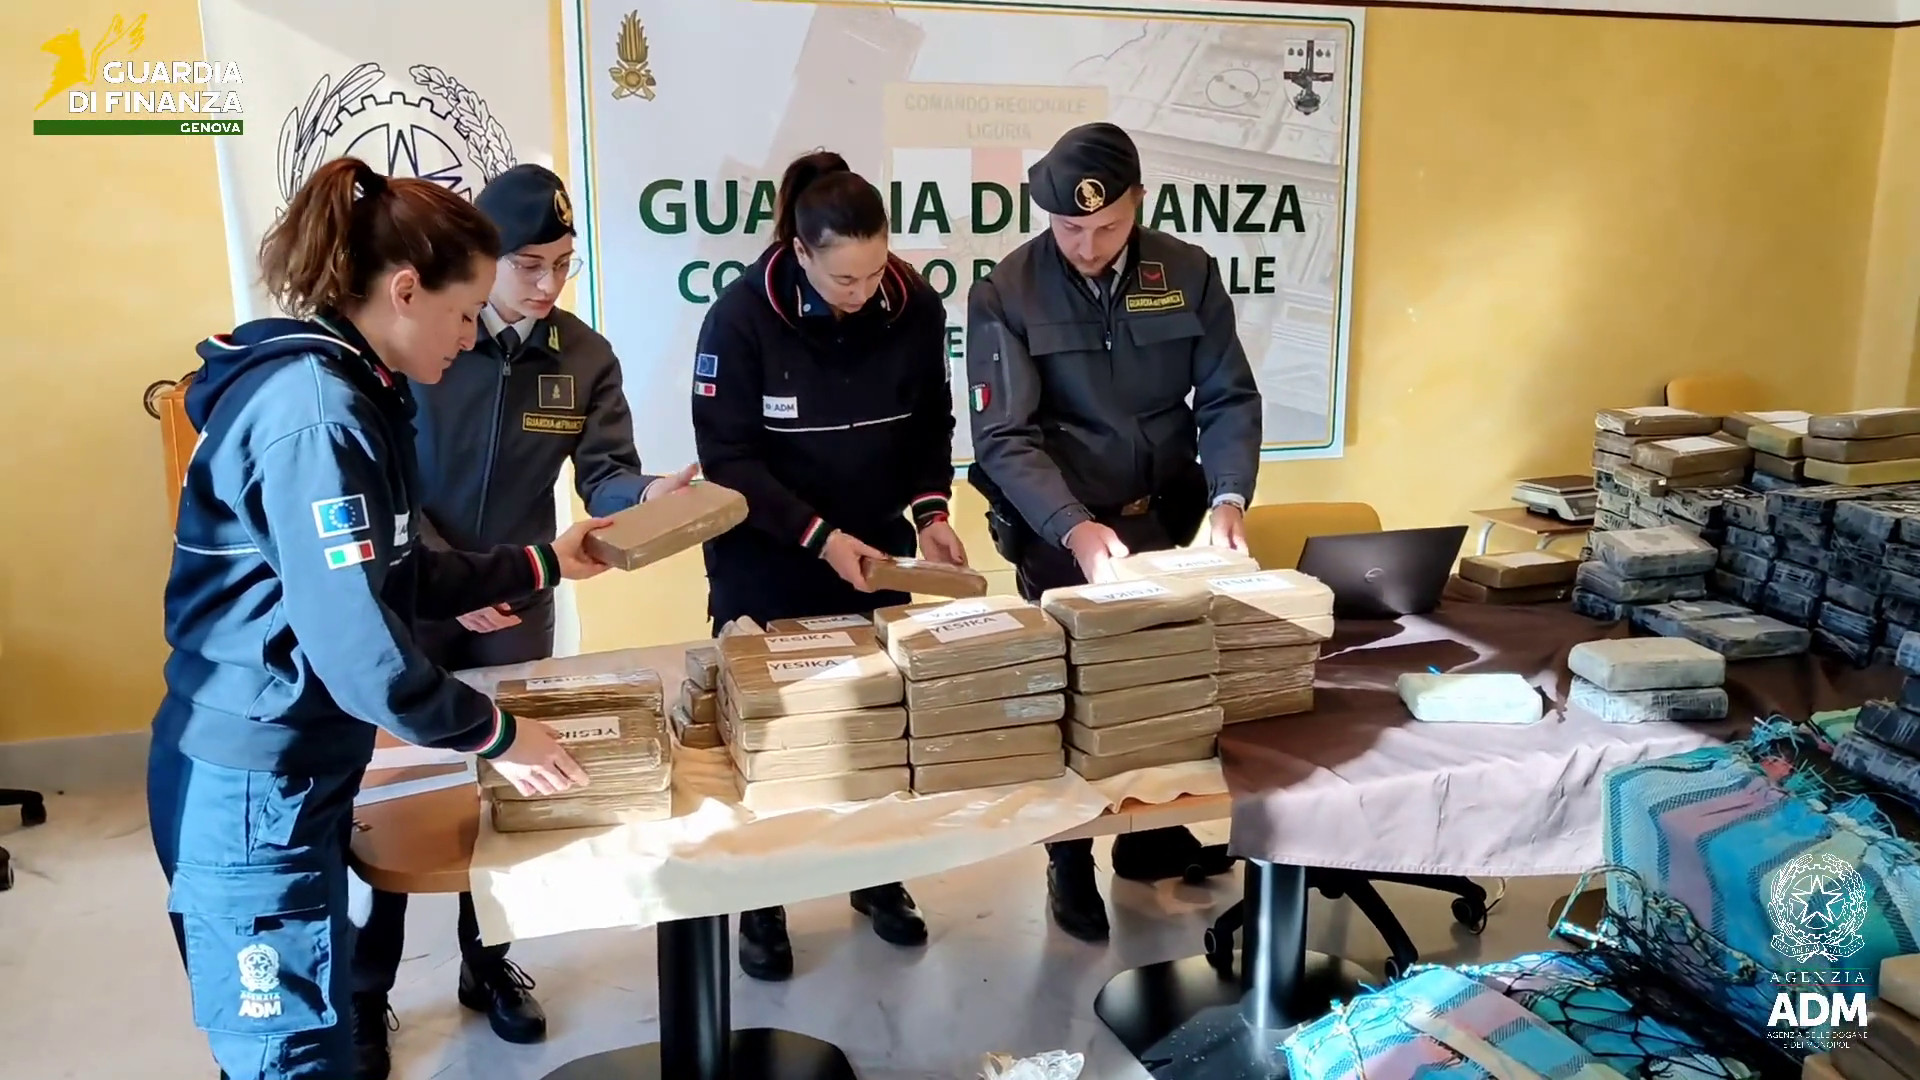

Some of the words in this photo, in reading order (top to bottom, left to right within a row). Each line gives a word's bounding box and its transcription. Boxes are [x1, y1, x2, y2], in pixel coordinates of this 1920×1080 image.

[904, 94, 990, 112] COMANDO
[995, 97, 1087, 115] REGIONALE
[967, 121, 1031, 140] LIGURIA
[639, 179, 951, 235] GUAIA
[971, 181, 1031, 235] DI
[774, 403, 795, 413] ADM
[799, 616, 850, 625] YESIKA
[931, 617, 997, 633] YESIKA
[767, 634, 833, 643] YESIKA
[770, 659, 840, 670] YESIKA
[558, 728, 618, 739] YESIK
[238, 1000, 282, 1018] ADM
